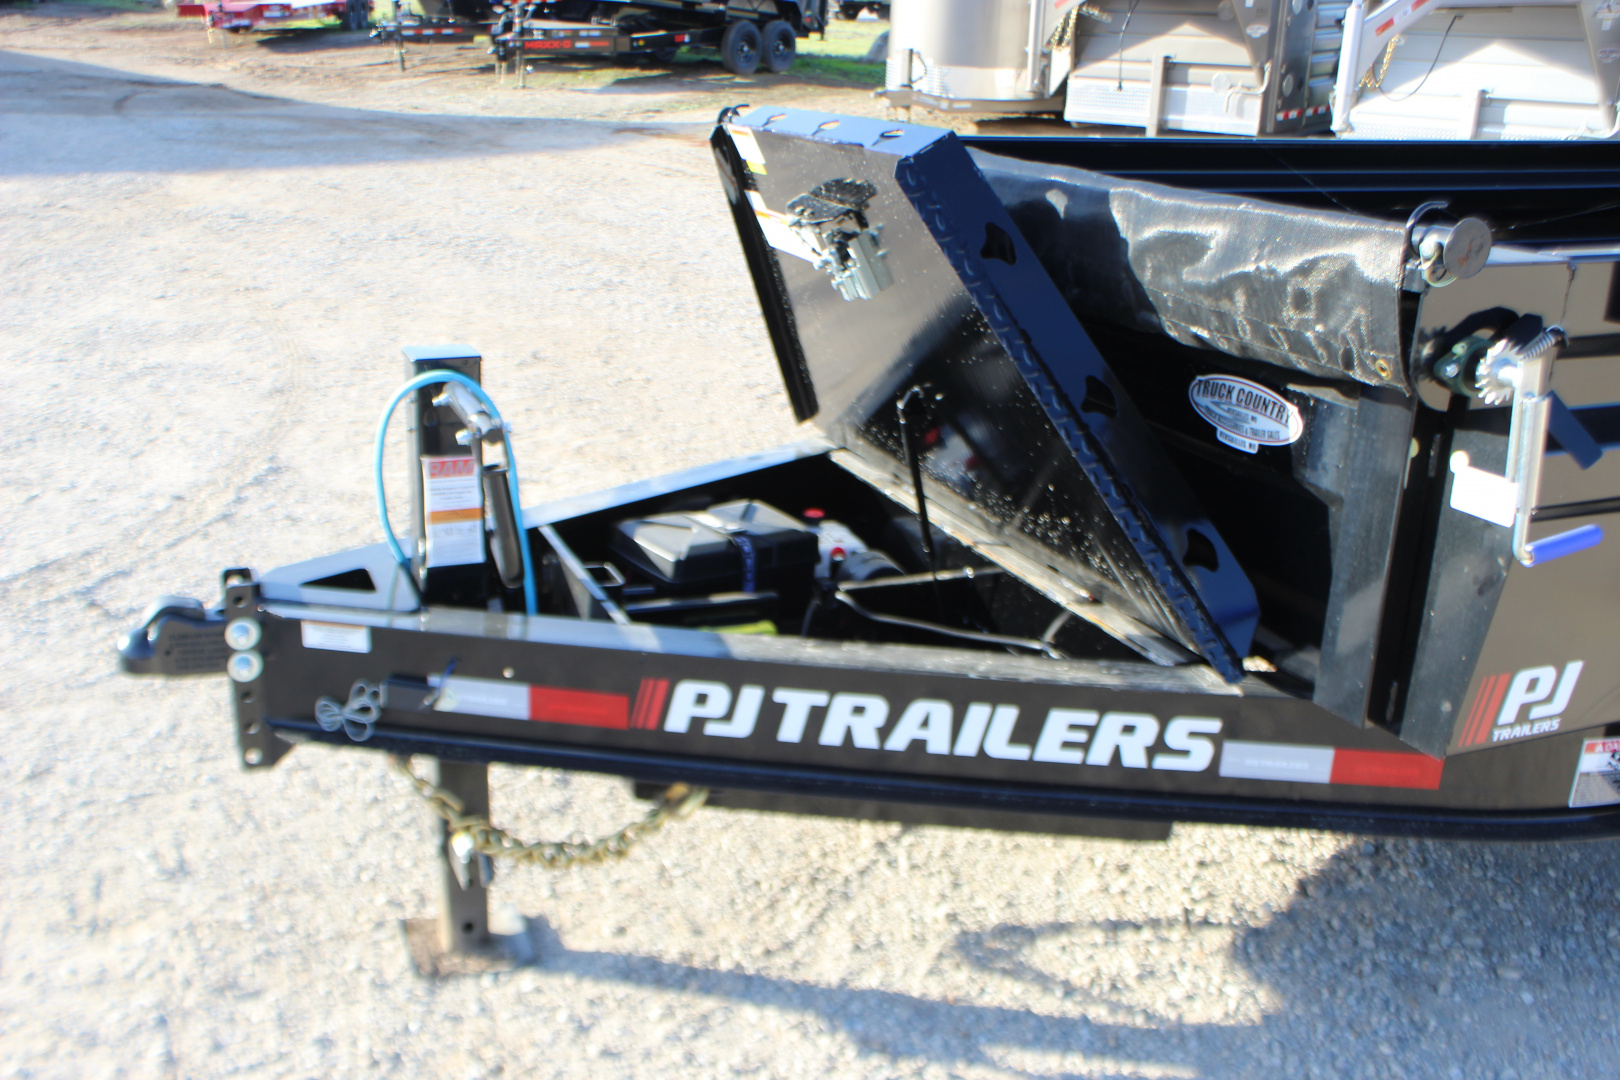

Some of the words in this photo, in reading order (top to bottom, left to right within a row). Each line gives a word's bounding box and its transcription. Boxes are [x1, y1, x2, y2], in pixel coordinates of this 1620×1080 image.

[1196, 379, 1235, 401] TRUCK
[1236, 387, 1292, 424] COUNTRY
[1497, 660, 1584, 726] PJ
[664, 679, 765, 739] PJ
[772, 687, 1223, 772] TRAILERS
[1492, 717, 1562, 742] TRAILERS
